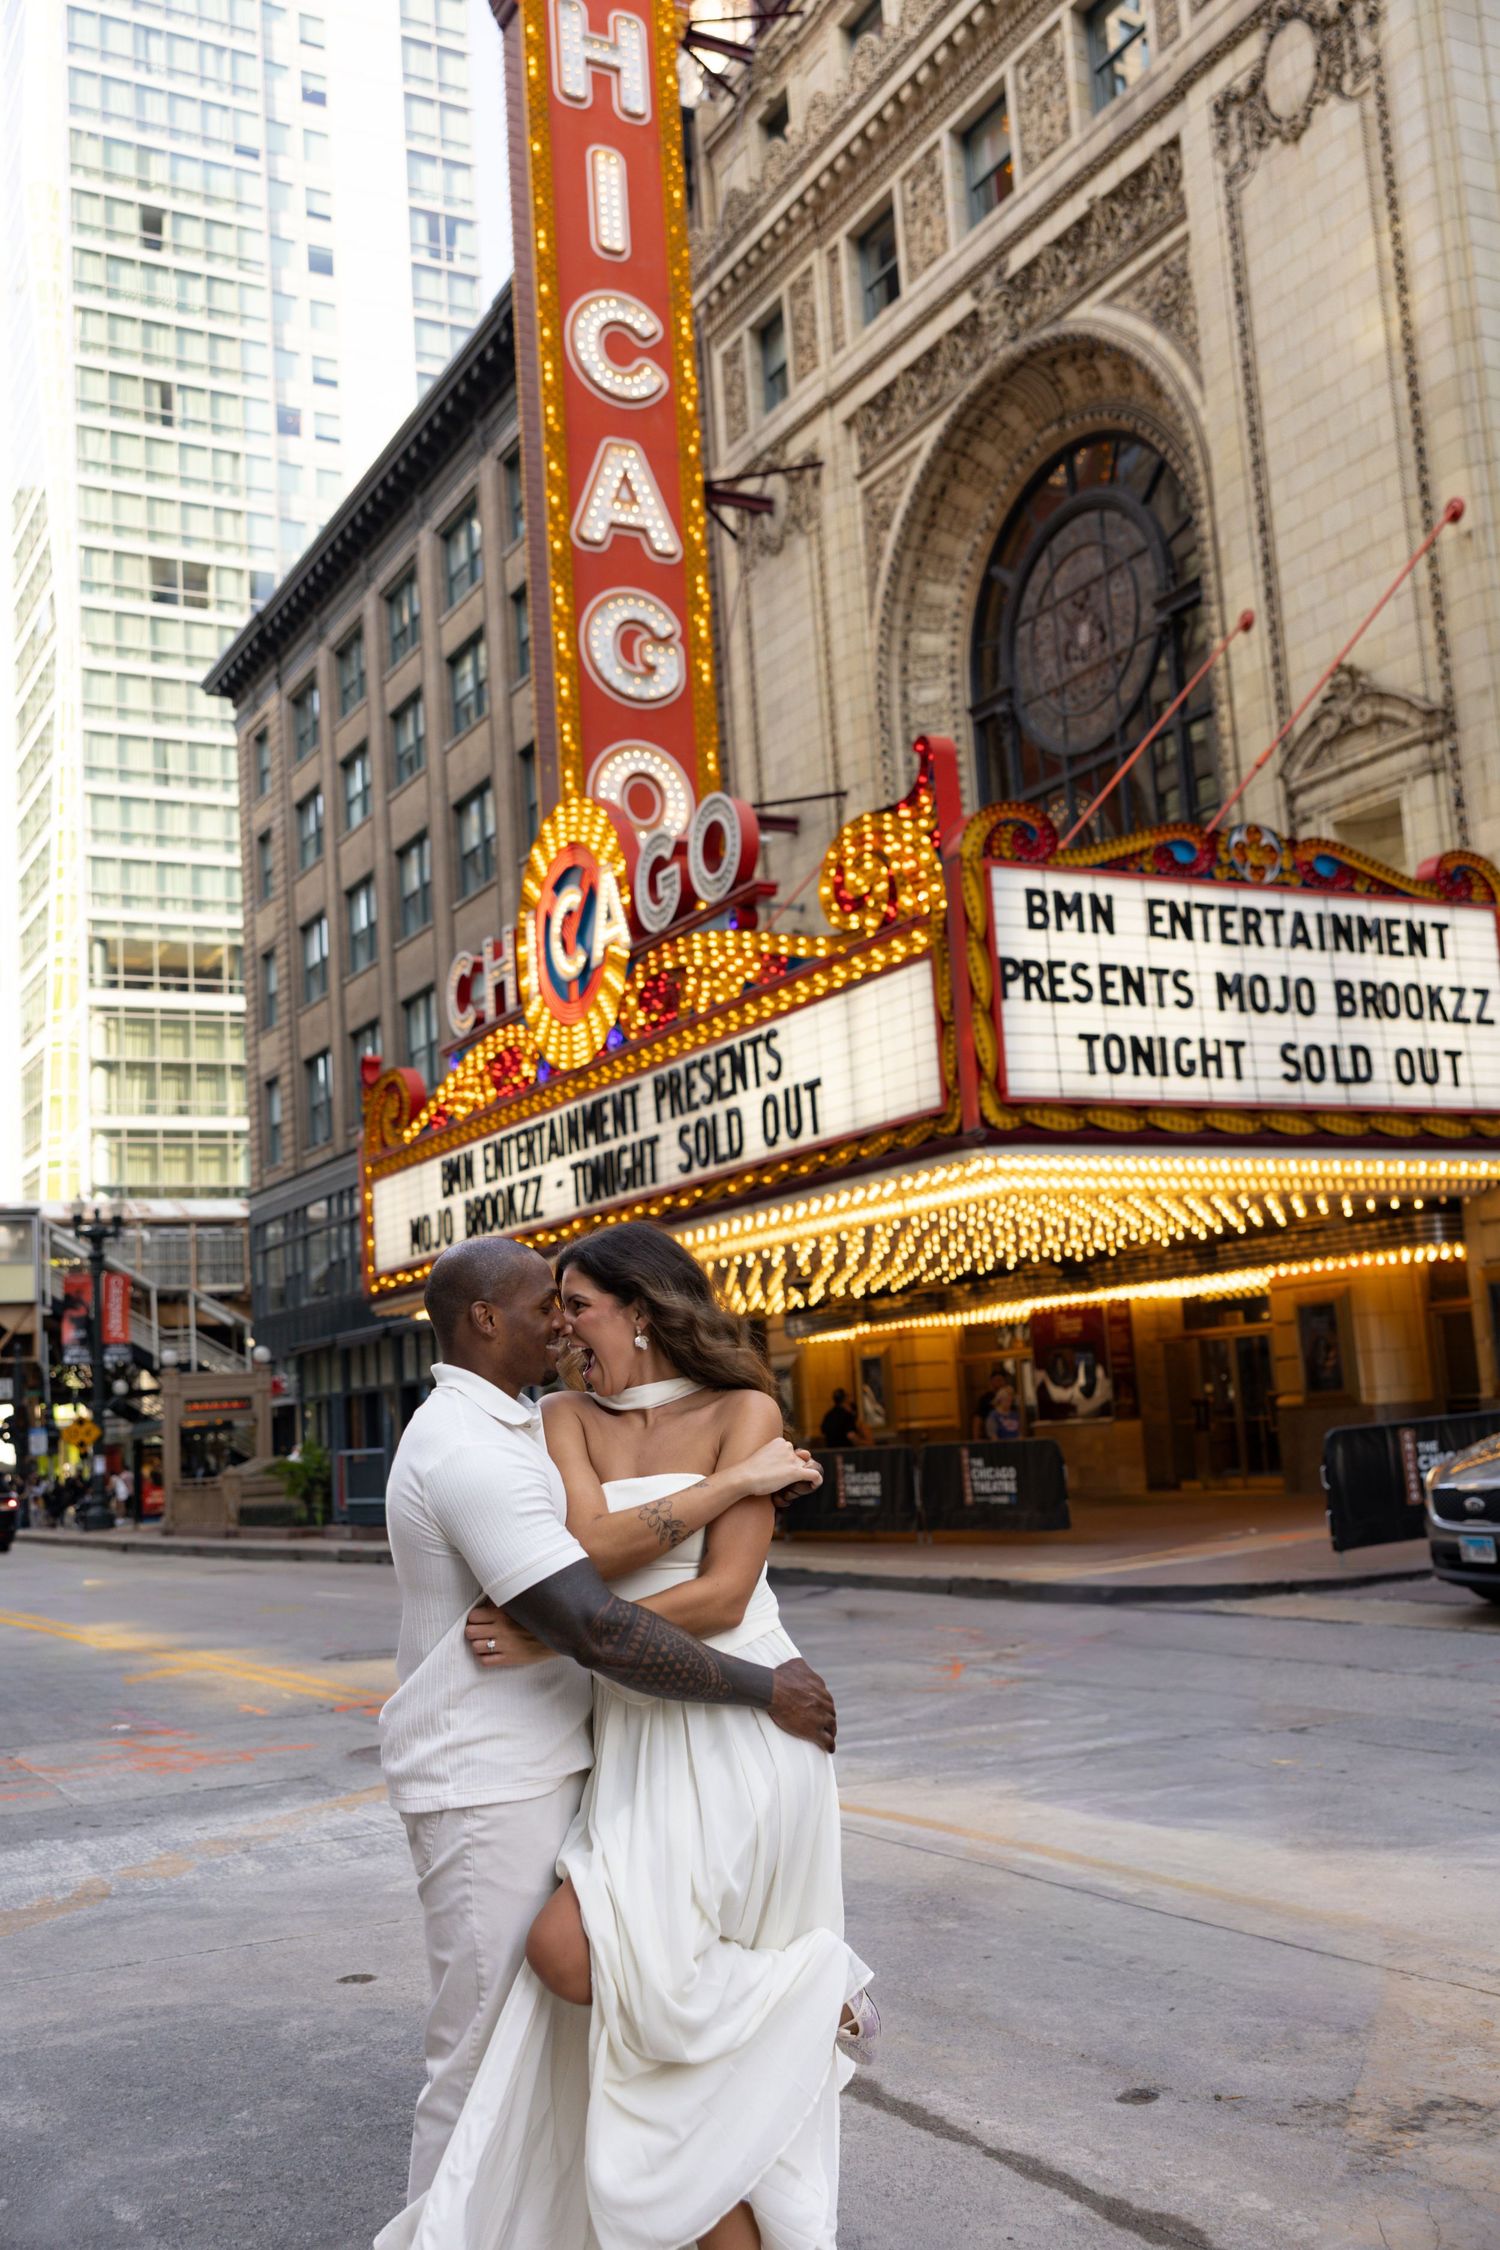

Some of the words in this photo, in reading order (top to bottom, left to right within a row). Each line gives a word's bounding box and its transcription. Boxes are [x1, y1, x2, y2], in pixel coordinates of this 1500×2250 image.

[446, 791, 745, 1039] CHICAGO
[1024, 887, 1116, 935] BMN
[1147, 897, 1450, 960] ENTERTAINMENT
[1001, 956, 1194, 1009] PRESENTS
[1215, 971, 1317, 1017] MOJO
[1335, 979, 1496, 1026] BROOKZZ
[1078, 1032, 1247, 1081] TONIGHT
[1279, 1041, 1374, 1084] SOLD
[1395, 1047, 1463, 1088] OUT
[441, 1149, 475, 1199] BMN
[483, 1083, 641, 1184] ENTERTAINMENT
[653, 1028, 783, 1124] PRESENTS
[409, 1206, 454, 1257] MOJO
[464, 1175, 544, 1238] BROOKZZ
[570, 1134, 660, 1207] TONIGHT
[678, 1107, 744, 1174] SOLD
[1417, 1450, 1456, 1470] CHIC
